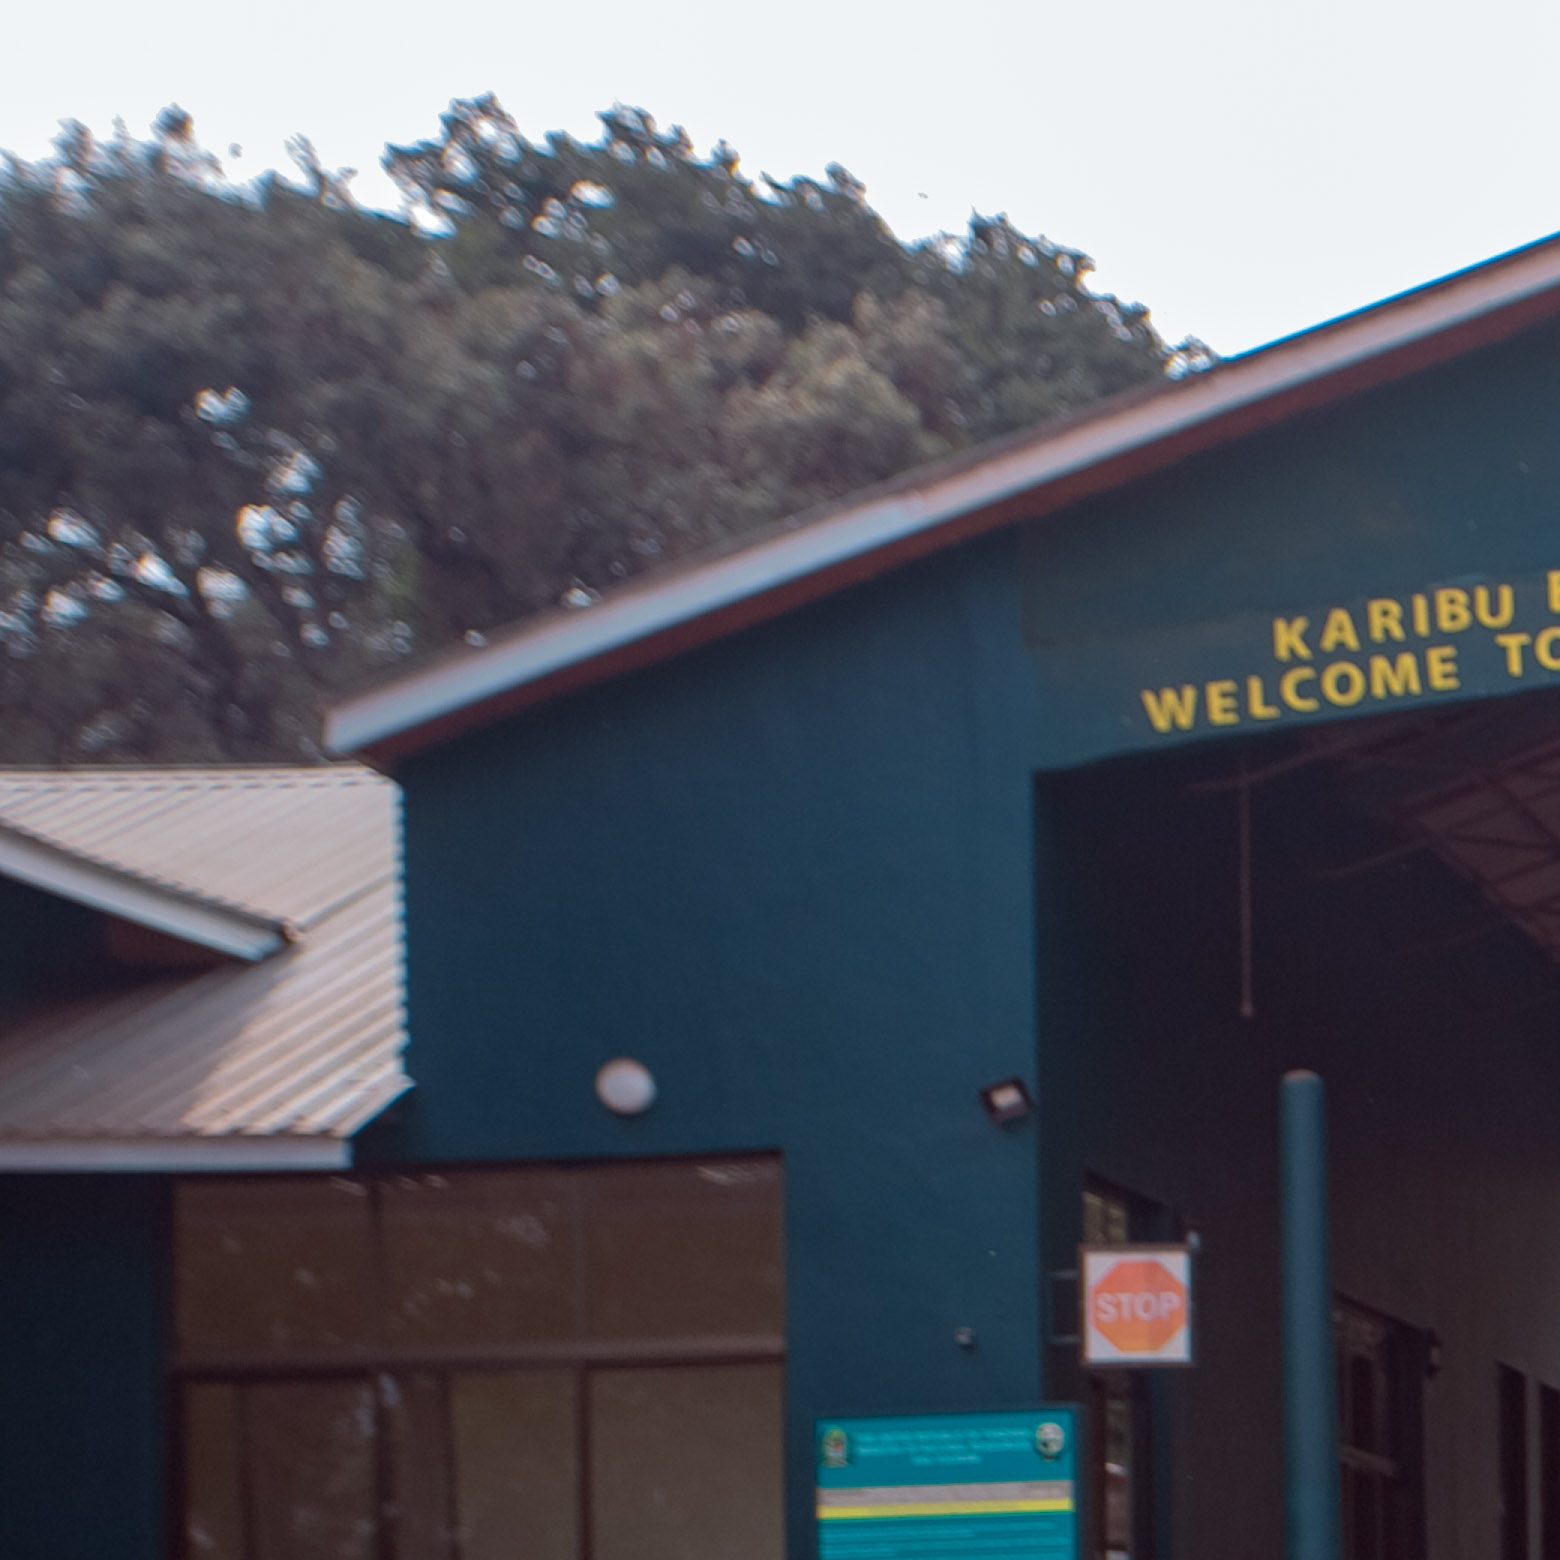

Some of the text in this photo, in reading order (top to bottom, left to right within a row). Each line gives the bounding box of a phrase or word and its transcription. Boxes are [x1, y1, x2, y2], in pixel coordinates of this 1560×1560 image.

[1274, 586, 1513, 661] KARIBU
[1142, 646, 1458, 732] WELCOME
[1097, 1291, 1181, 1323] STOP
